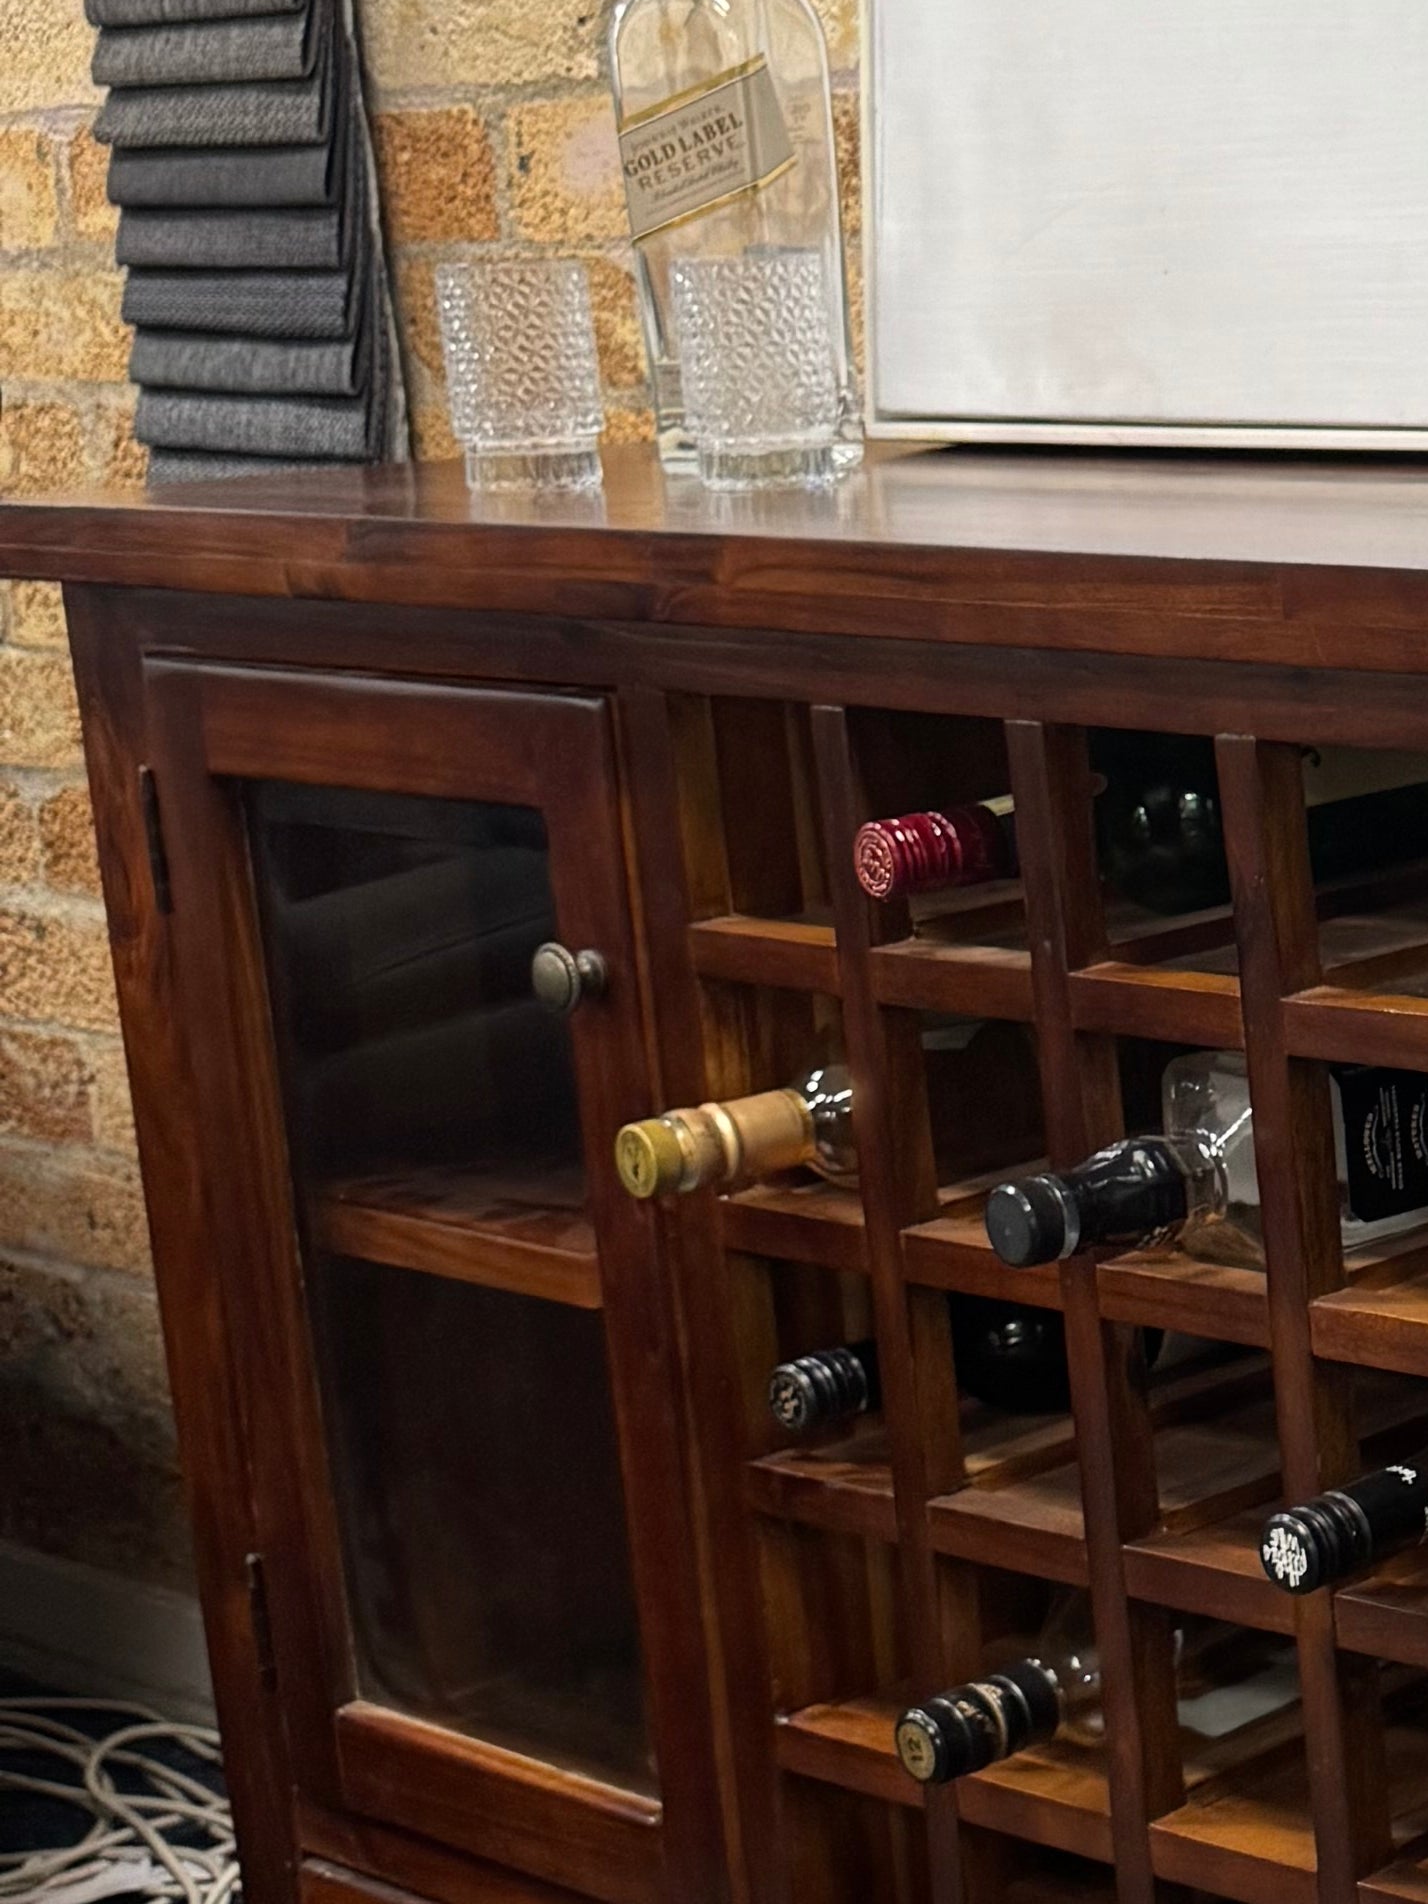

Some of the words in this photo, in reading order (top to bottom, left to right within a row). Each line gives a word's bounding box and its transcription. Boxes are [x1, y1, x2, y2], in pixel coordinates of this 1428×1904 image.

[623, 142, 676, 179] GOLD
[678, 112, 744, 154] LABEL
[637, 134, 743, 192] RESERVE
